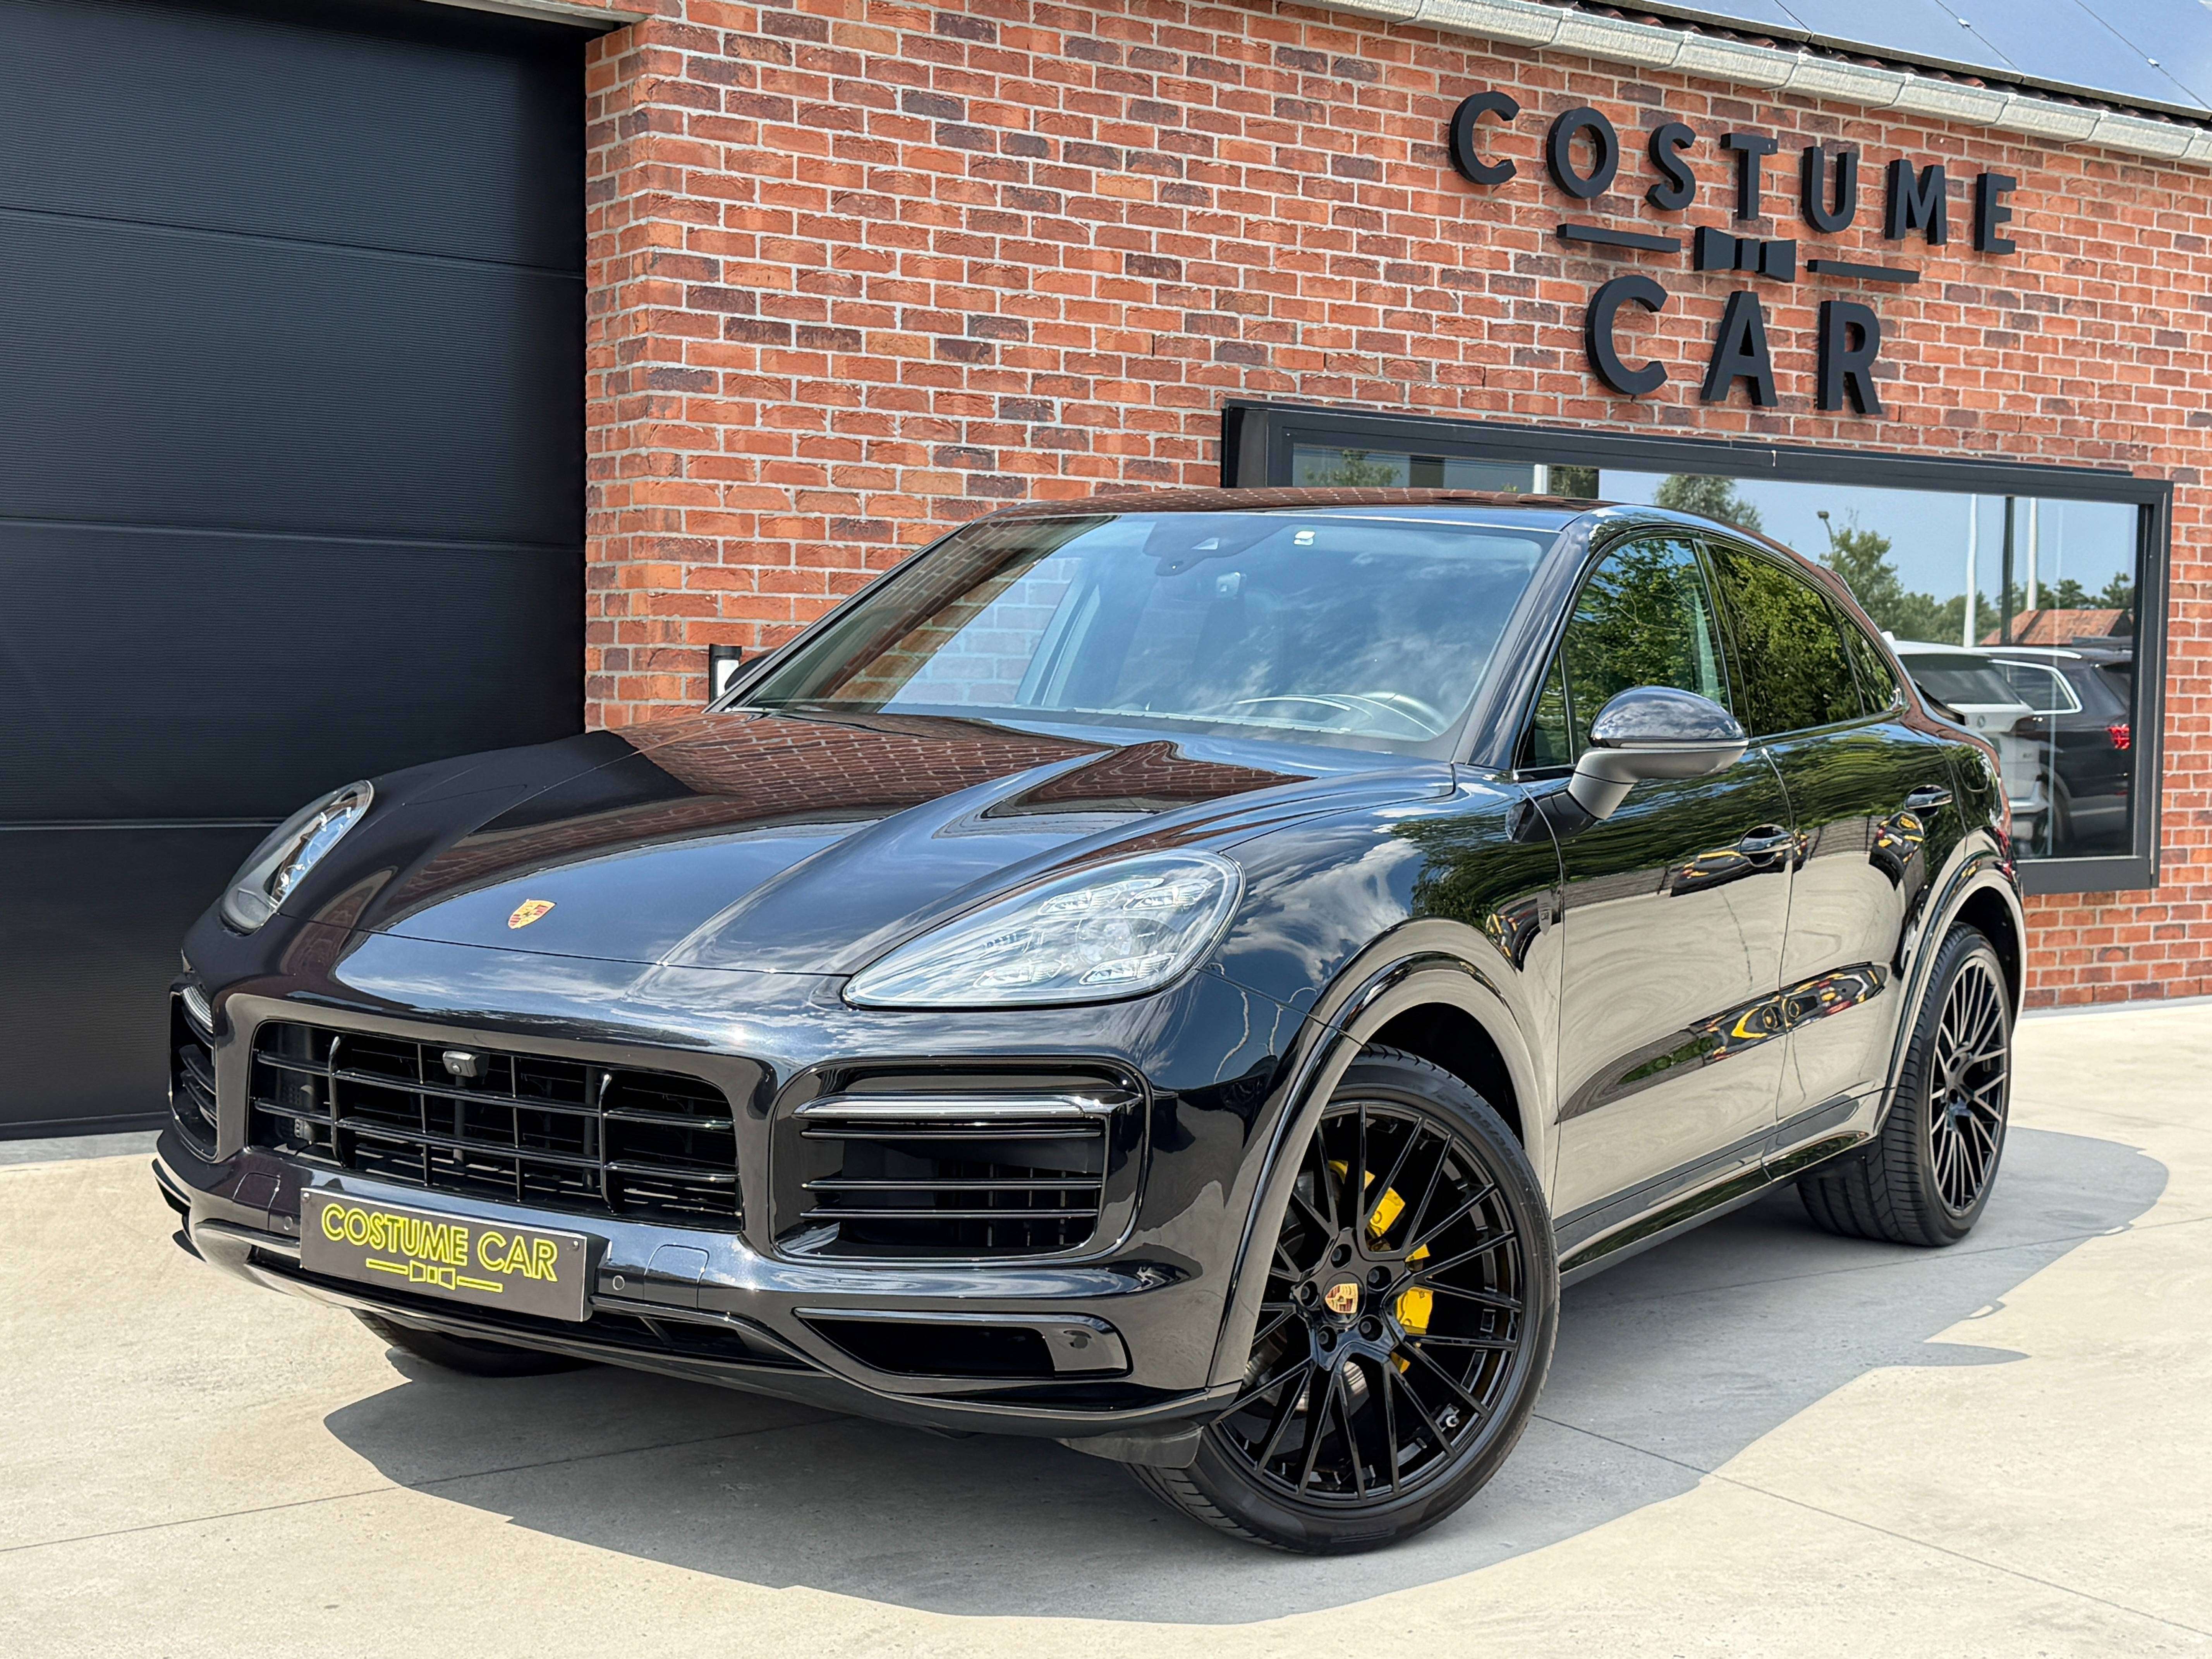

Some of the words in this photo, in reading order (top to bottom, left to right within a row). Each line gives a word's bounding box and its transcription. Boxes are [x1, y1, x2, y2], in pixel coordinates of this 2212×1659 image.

[1449, 91, 2016, 254] COSTUME
[1585, 275, 1882, 415] CAR
[322, 1203, 468, 1266] COSTUME
[477, 1231, 558, 1282] CAR
